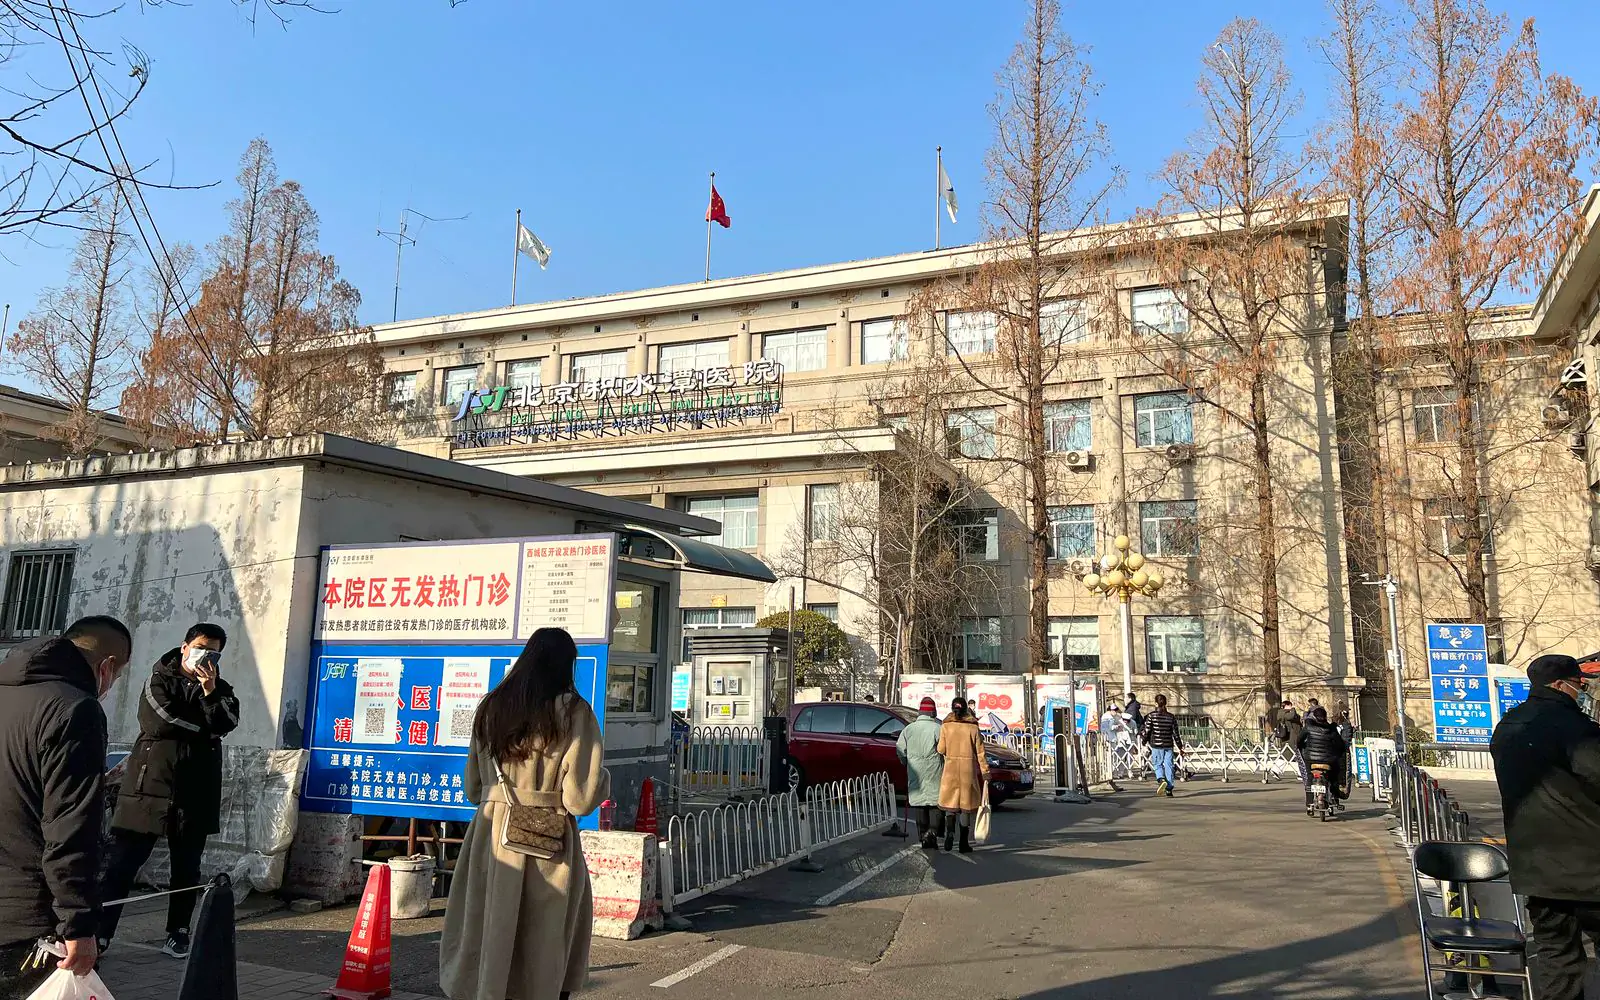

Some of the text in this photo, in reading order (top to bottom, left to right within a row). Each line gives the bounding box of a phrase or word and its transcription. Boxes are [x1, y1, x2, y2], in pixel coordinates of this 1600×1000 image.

[508, 357, 779, 408] 北京积水潭医院
[511, 412, 533, 425] BEI
[550, 409, 583, 422] JING
[623, 401, 656, 415] SHUI
[671, 398, 695, 411] TAN
[705, 389, 780, 407] HOSPITAL
[456, 432, 472, 442] THE
[476, 428, 511, 440] FOURTH
[564, 420, 604, 434] MEDICAL
[659, 413, 671, 424] OF
[526, 546, 606, 558] 西城区开设发热门诊医院
[321, 572, 511, 609] 本院区无发热门诊
[319, 618, 511, 632] 请发热患者就近前往设有发热门诊的医疗机构就诊。
[1439, 627, 1473, 640] 急诊
[1440, 678, 1480, 689] 中药房
[977, 692, 1013, 710] 100
[327, 783, 470, 804] 门诊的医院就医。给您造成
